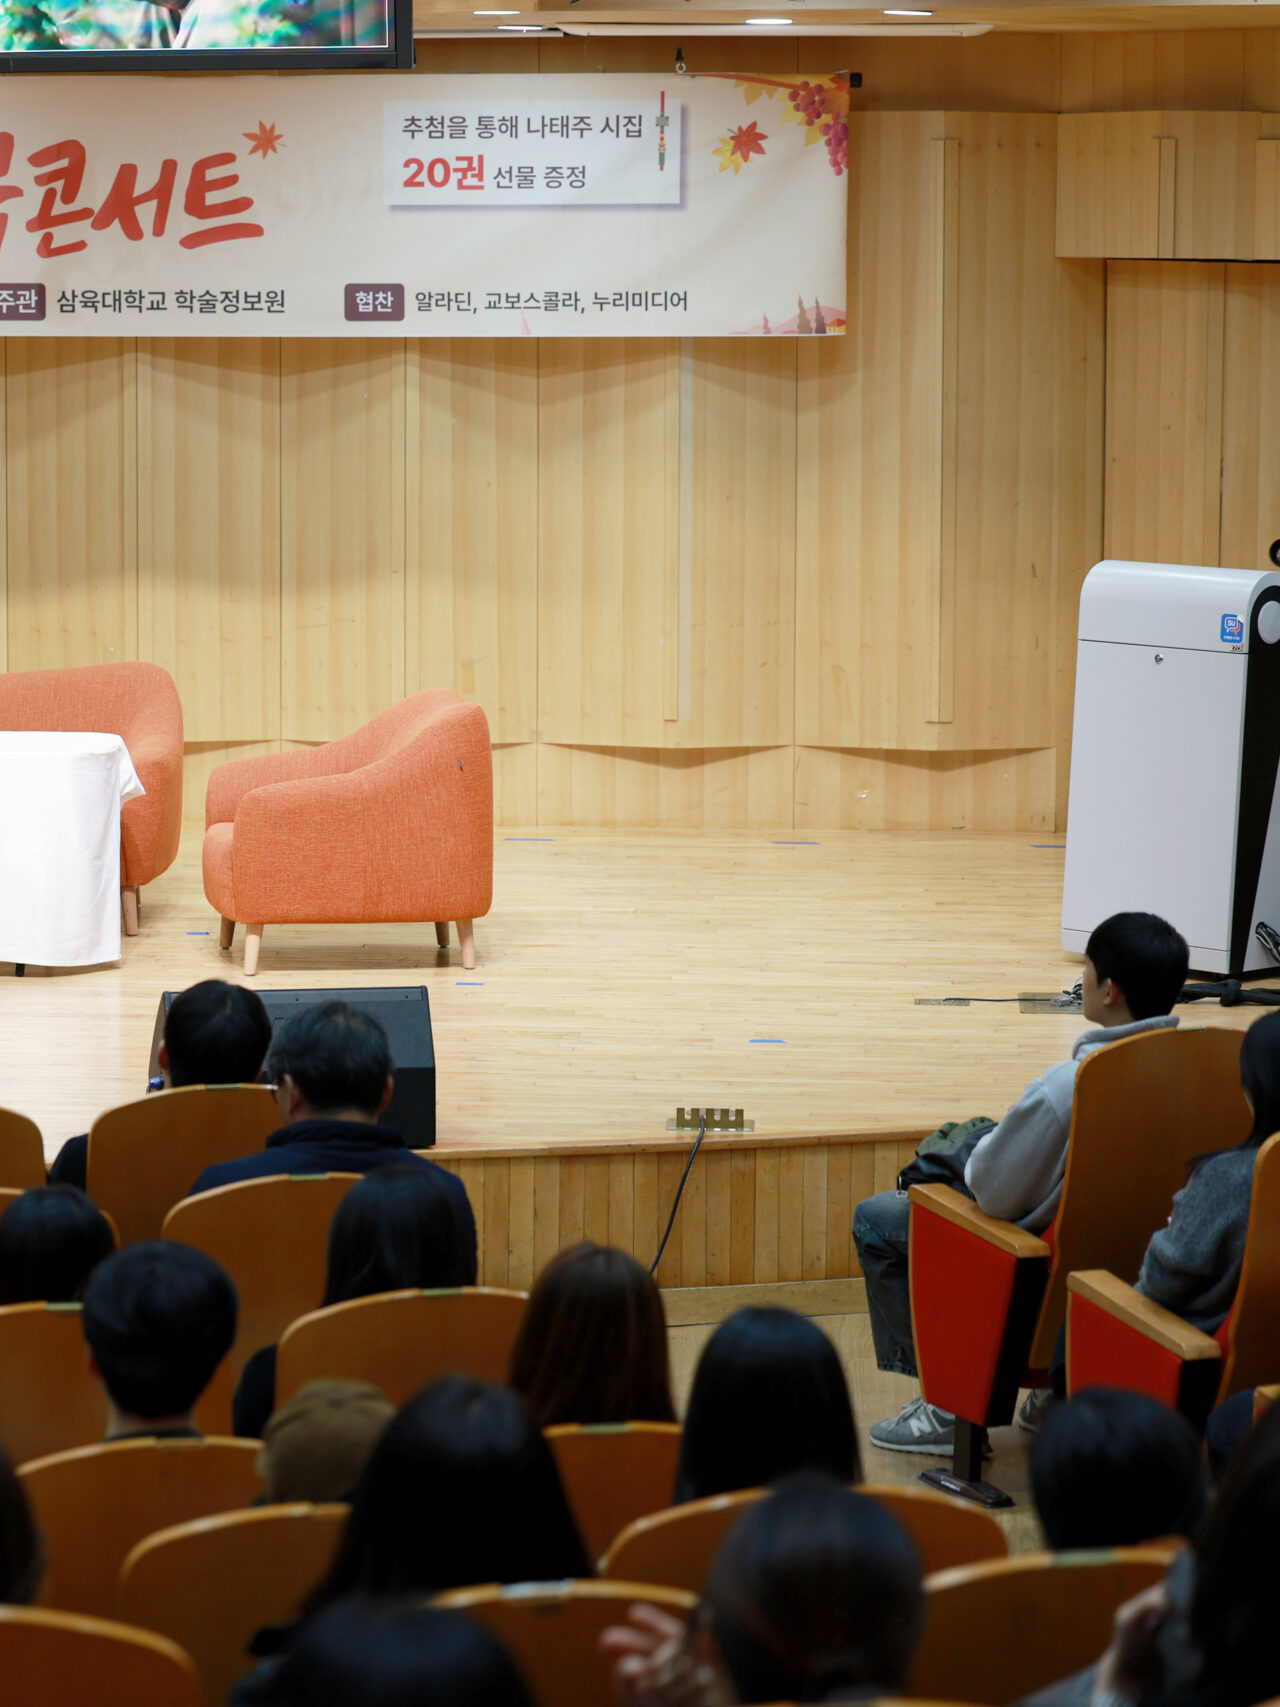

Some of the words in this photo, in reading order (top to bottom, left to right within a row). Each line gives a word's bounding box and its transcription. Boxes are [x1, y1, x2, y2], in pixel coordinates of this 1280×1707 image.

[402, 115, 468, 139] 추첨을
[475, 115, 518, 139] 통해
[526, 115, 593, 139] 나태주
[600, 114, 643, 138] 시집
[403, 154, 485, 190] 20권
[493, 165, 536, 189] 선물
[543, 165, 586, 189] 증정
[56, 289, 168, 314] 삼육대학교
[174, 289, 285, 314] 학술정보원
[355, 290, 394, 312] 협찬
[415, 291, 477, 314] 알라딘,
[484, 291, 585, 314] 교보스콜라,
[592, 290, 689, 313] 누리미디어
